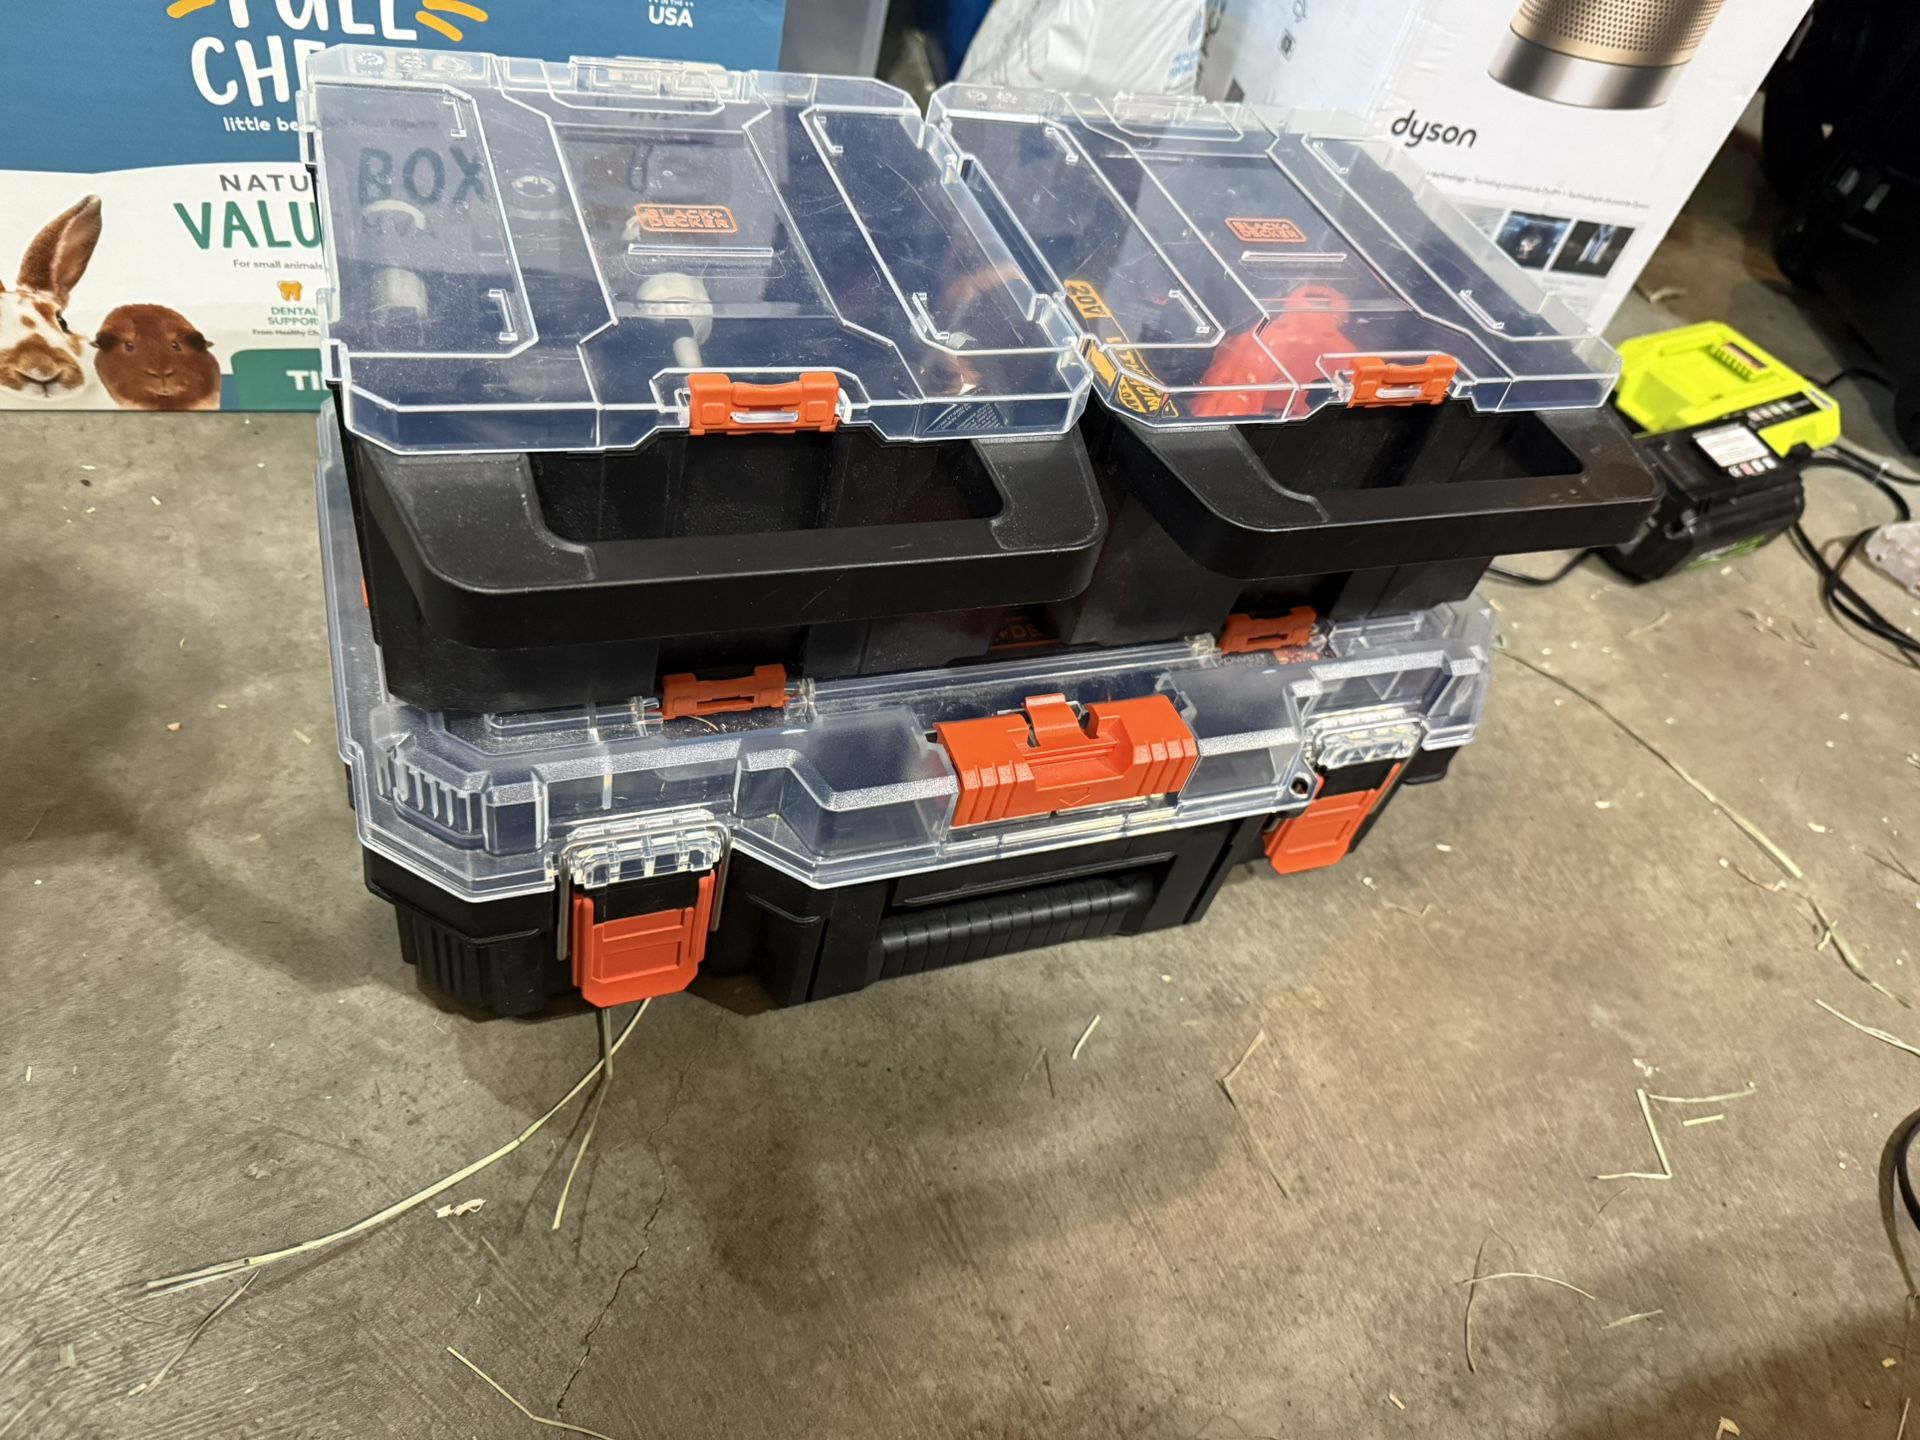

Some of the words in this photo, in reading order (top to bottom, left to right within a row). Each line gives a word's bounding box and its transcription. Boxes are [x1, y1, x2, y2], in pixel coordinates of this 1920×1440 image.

[649, 5, 694, 28] USA
[223, 117, 271, 132] little
[1391, 110, 1477, 149] dyson
[650, 217, 730, 229] DECKER
[233, 259, 251, 268] For
[253, 260, 281, 269] small
[284, 261, 324, 271] animals
